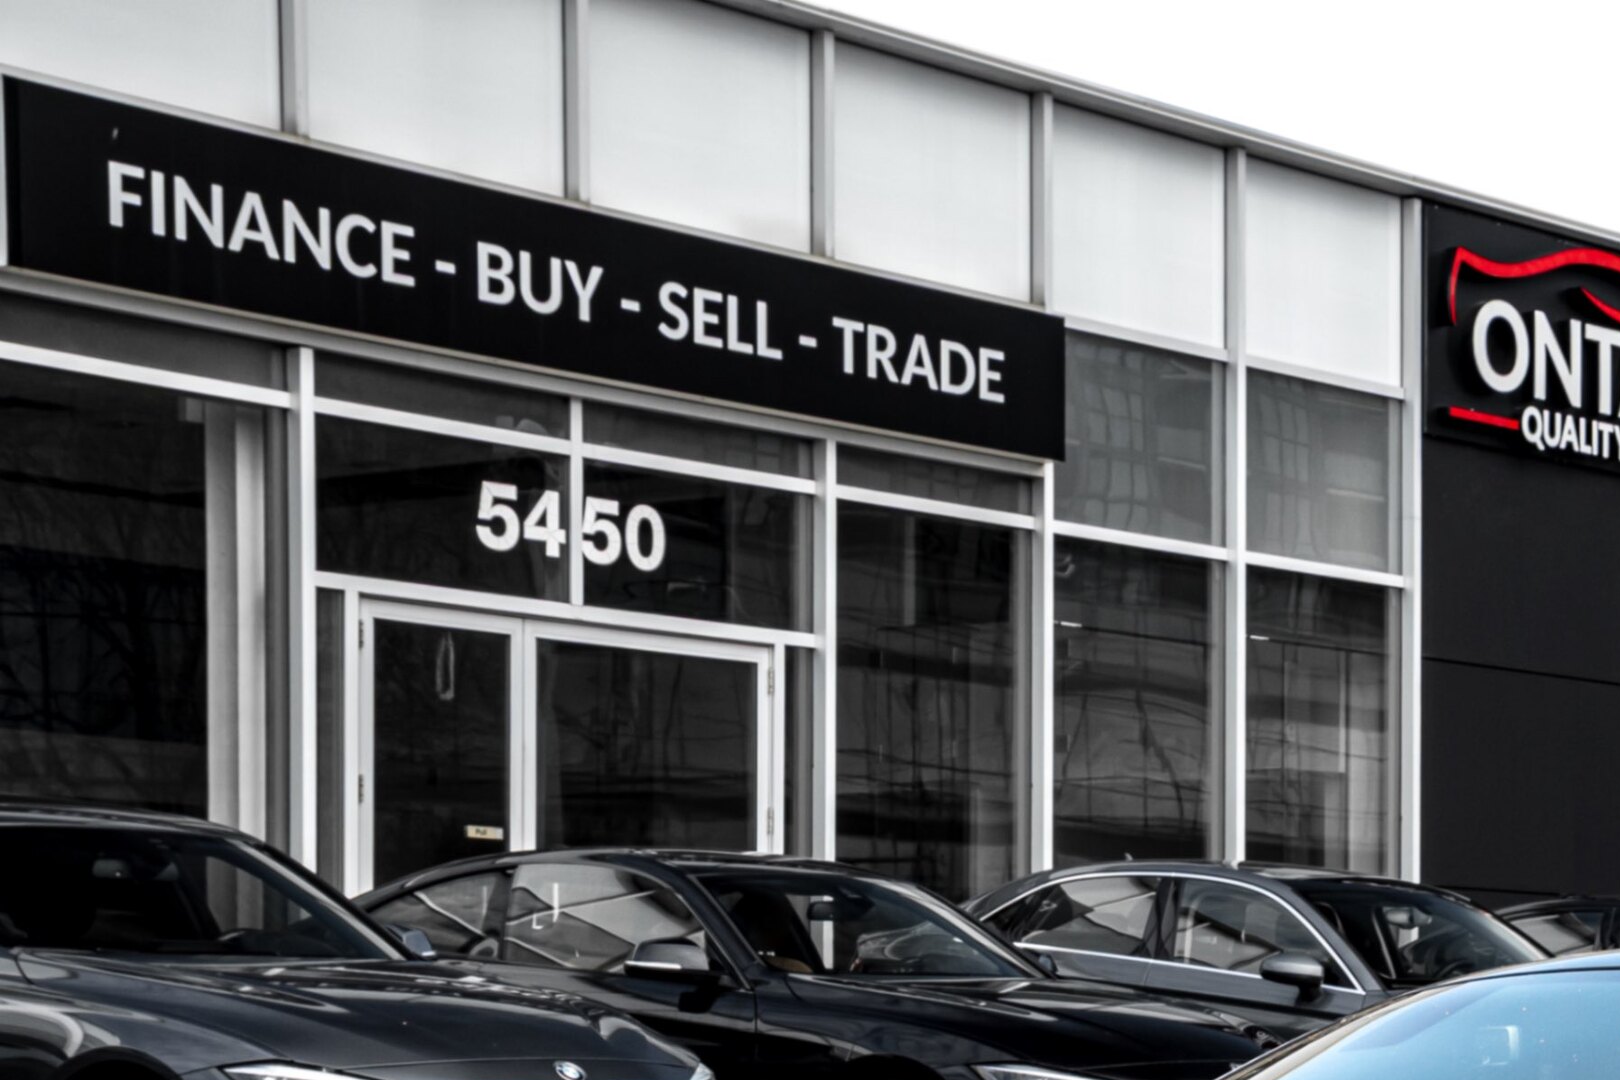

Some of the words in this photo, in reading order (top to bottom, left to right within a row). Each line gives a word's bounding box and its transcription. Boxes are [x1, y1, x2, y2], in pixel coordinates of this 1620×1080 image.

[108, 160, 416, 288] FINANCE
[476, 241, 604, 323] BUY
[658, 281, 783, 360] SELL
[832, 316, 1005, 404] TRADE
